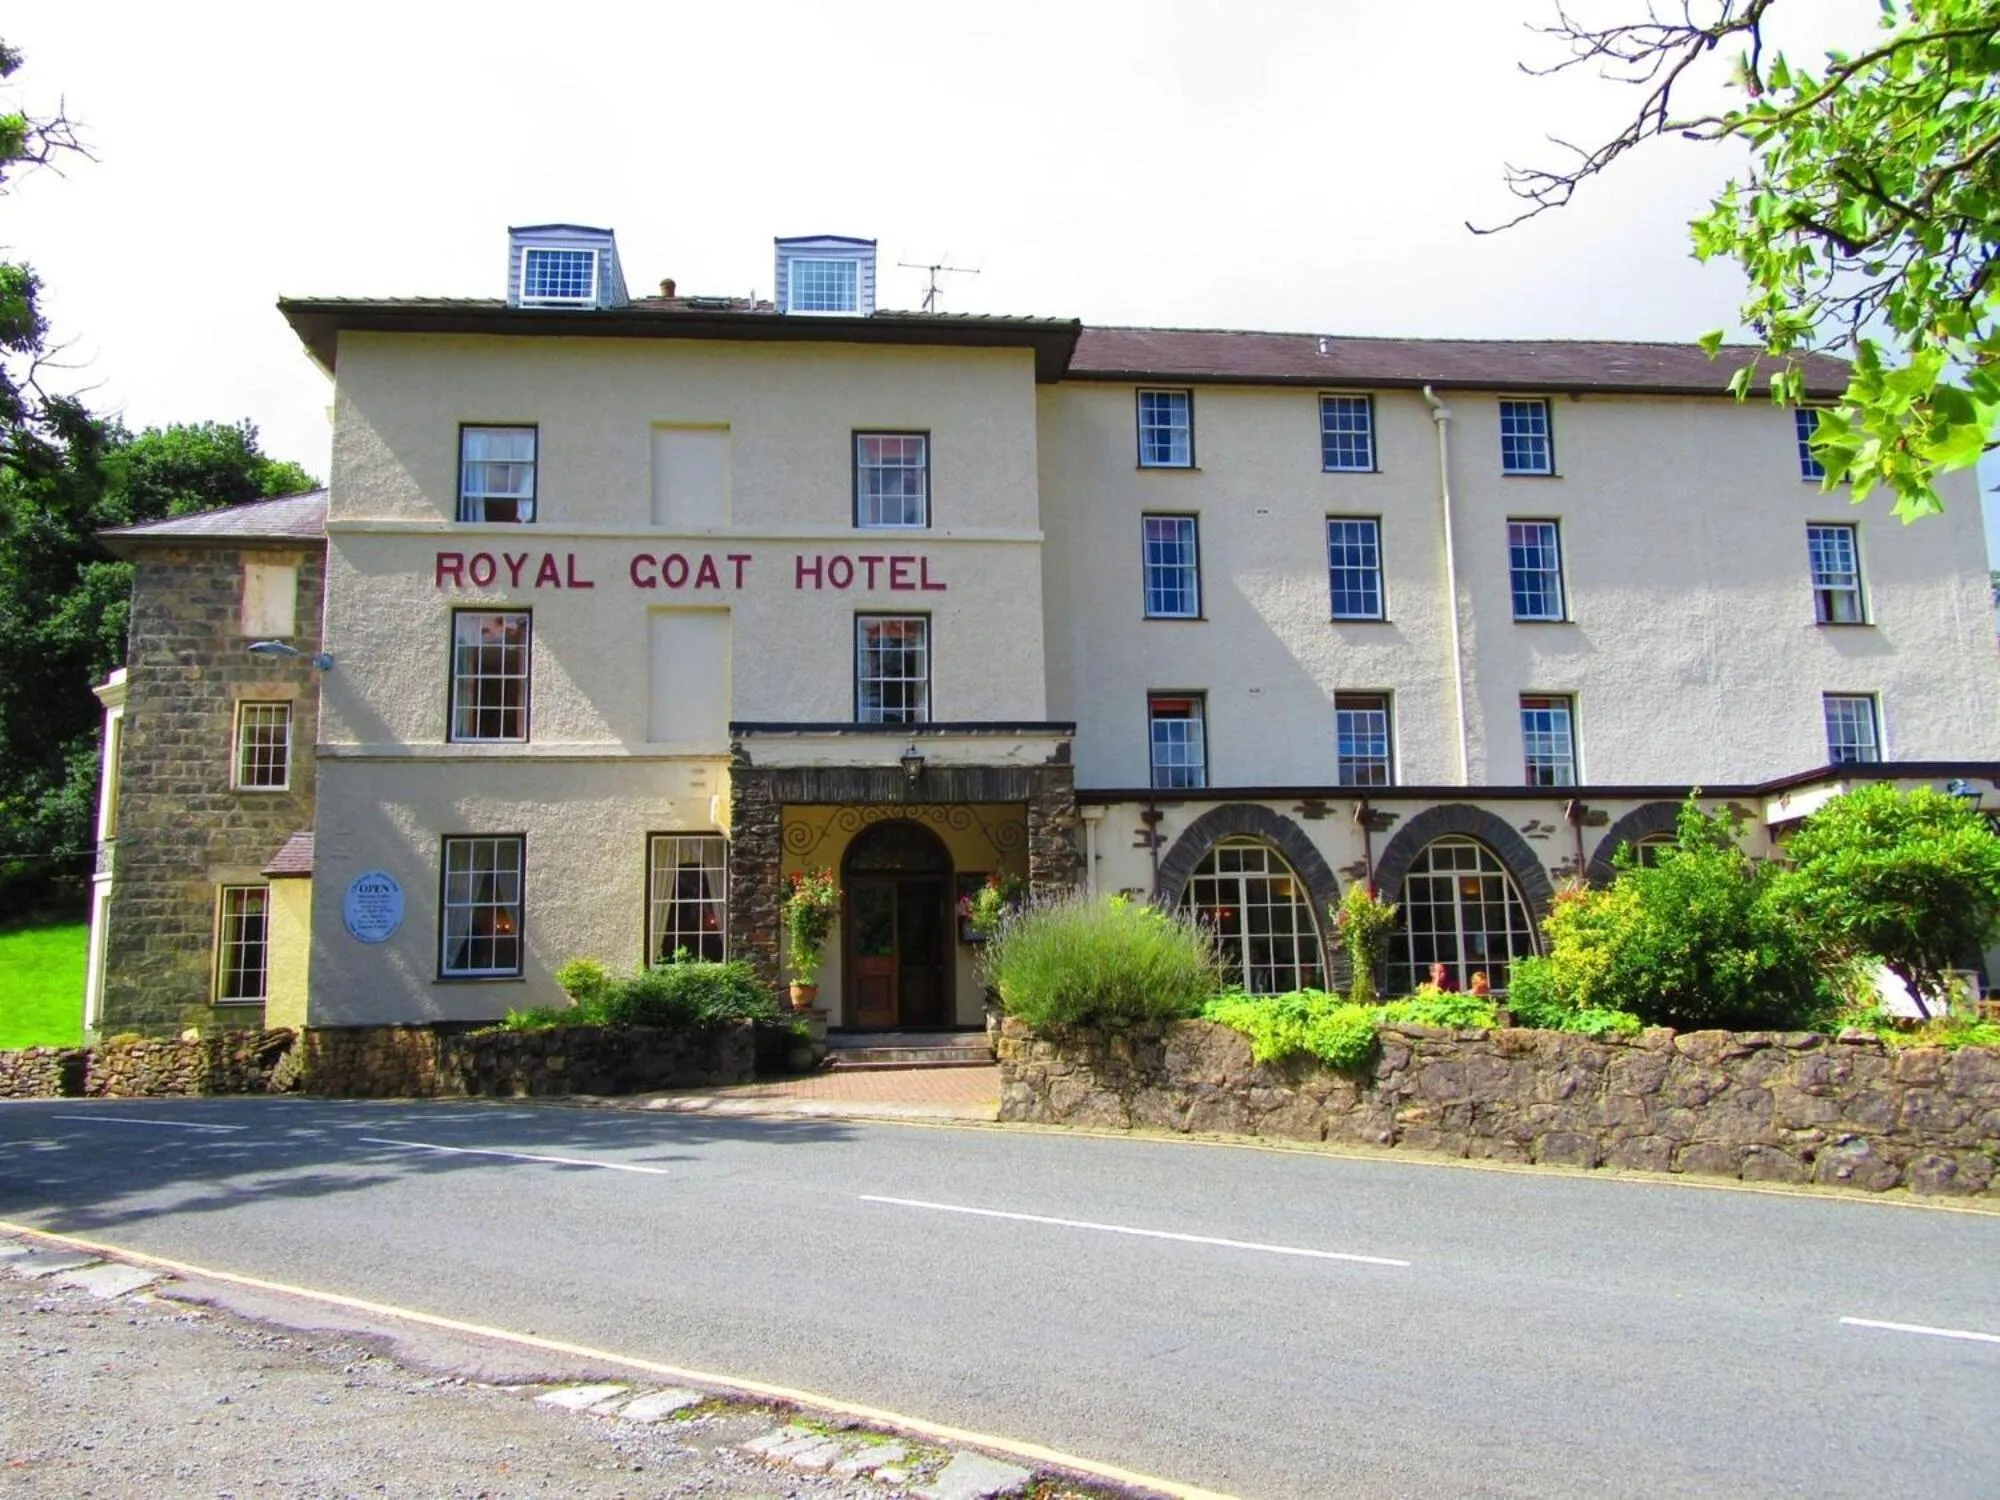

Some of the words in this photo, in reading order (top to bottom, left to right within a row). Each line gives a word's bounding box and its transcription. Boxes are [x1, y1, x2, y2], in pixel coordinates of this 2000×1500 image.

[436, 552, 594, 589] ROYAL
[630, 553, 752, 589] GOAT
[796, 555, 947, 591] HOTEL
[359, 884, 389, 893] OPEN
